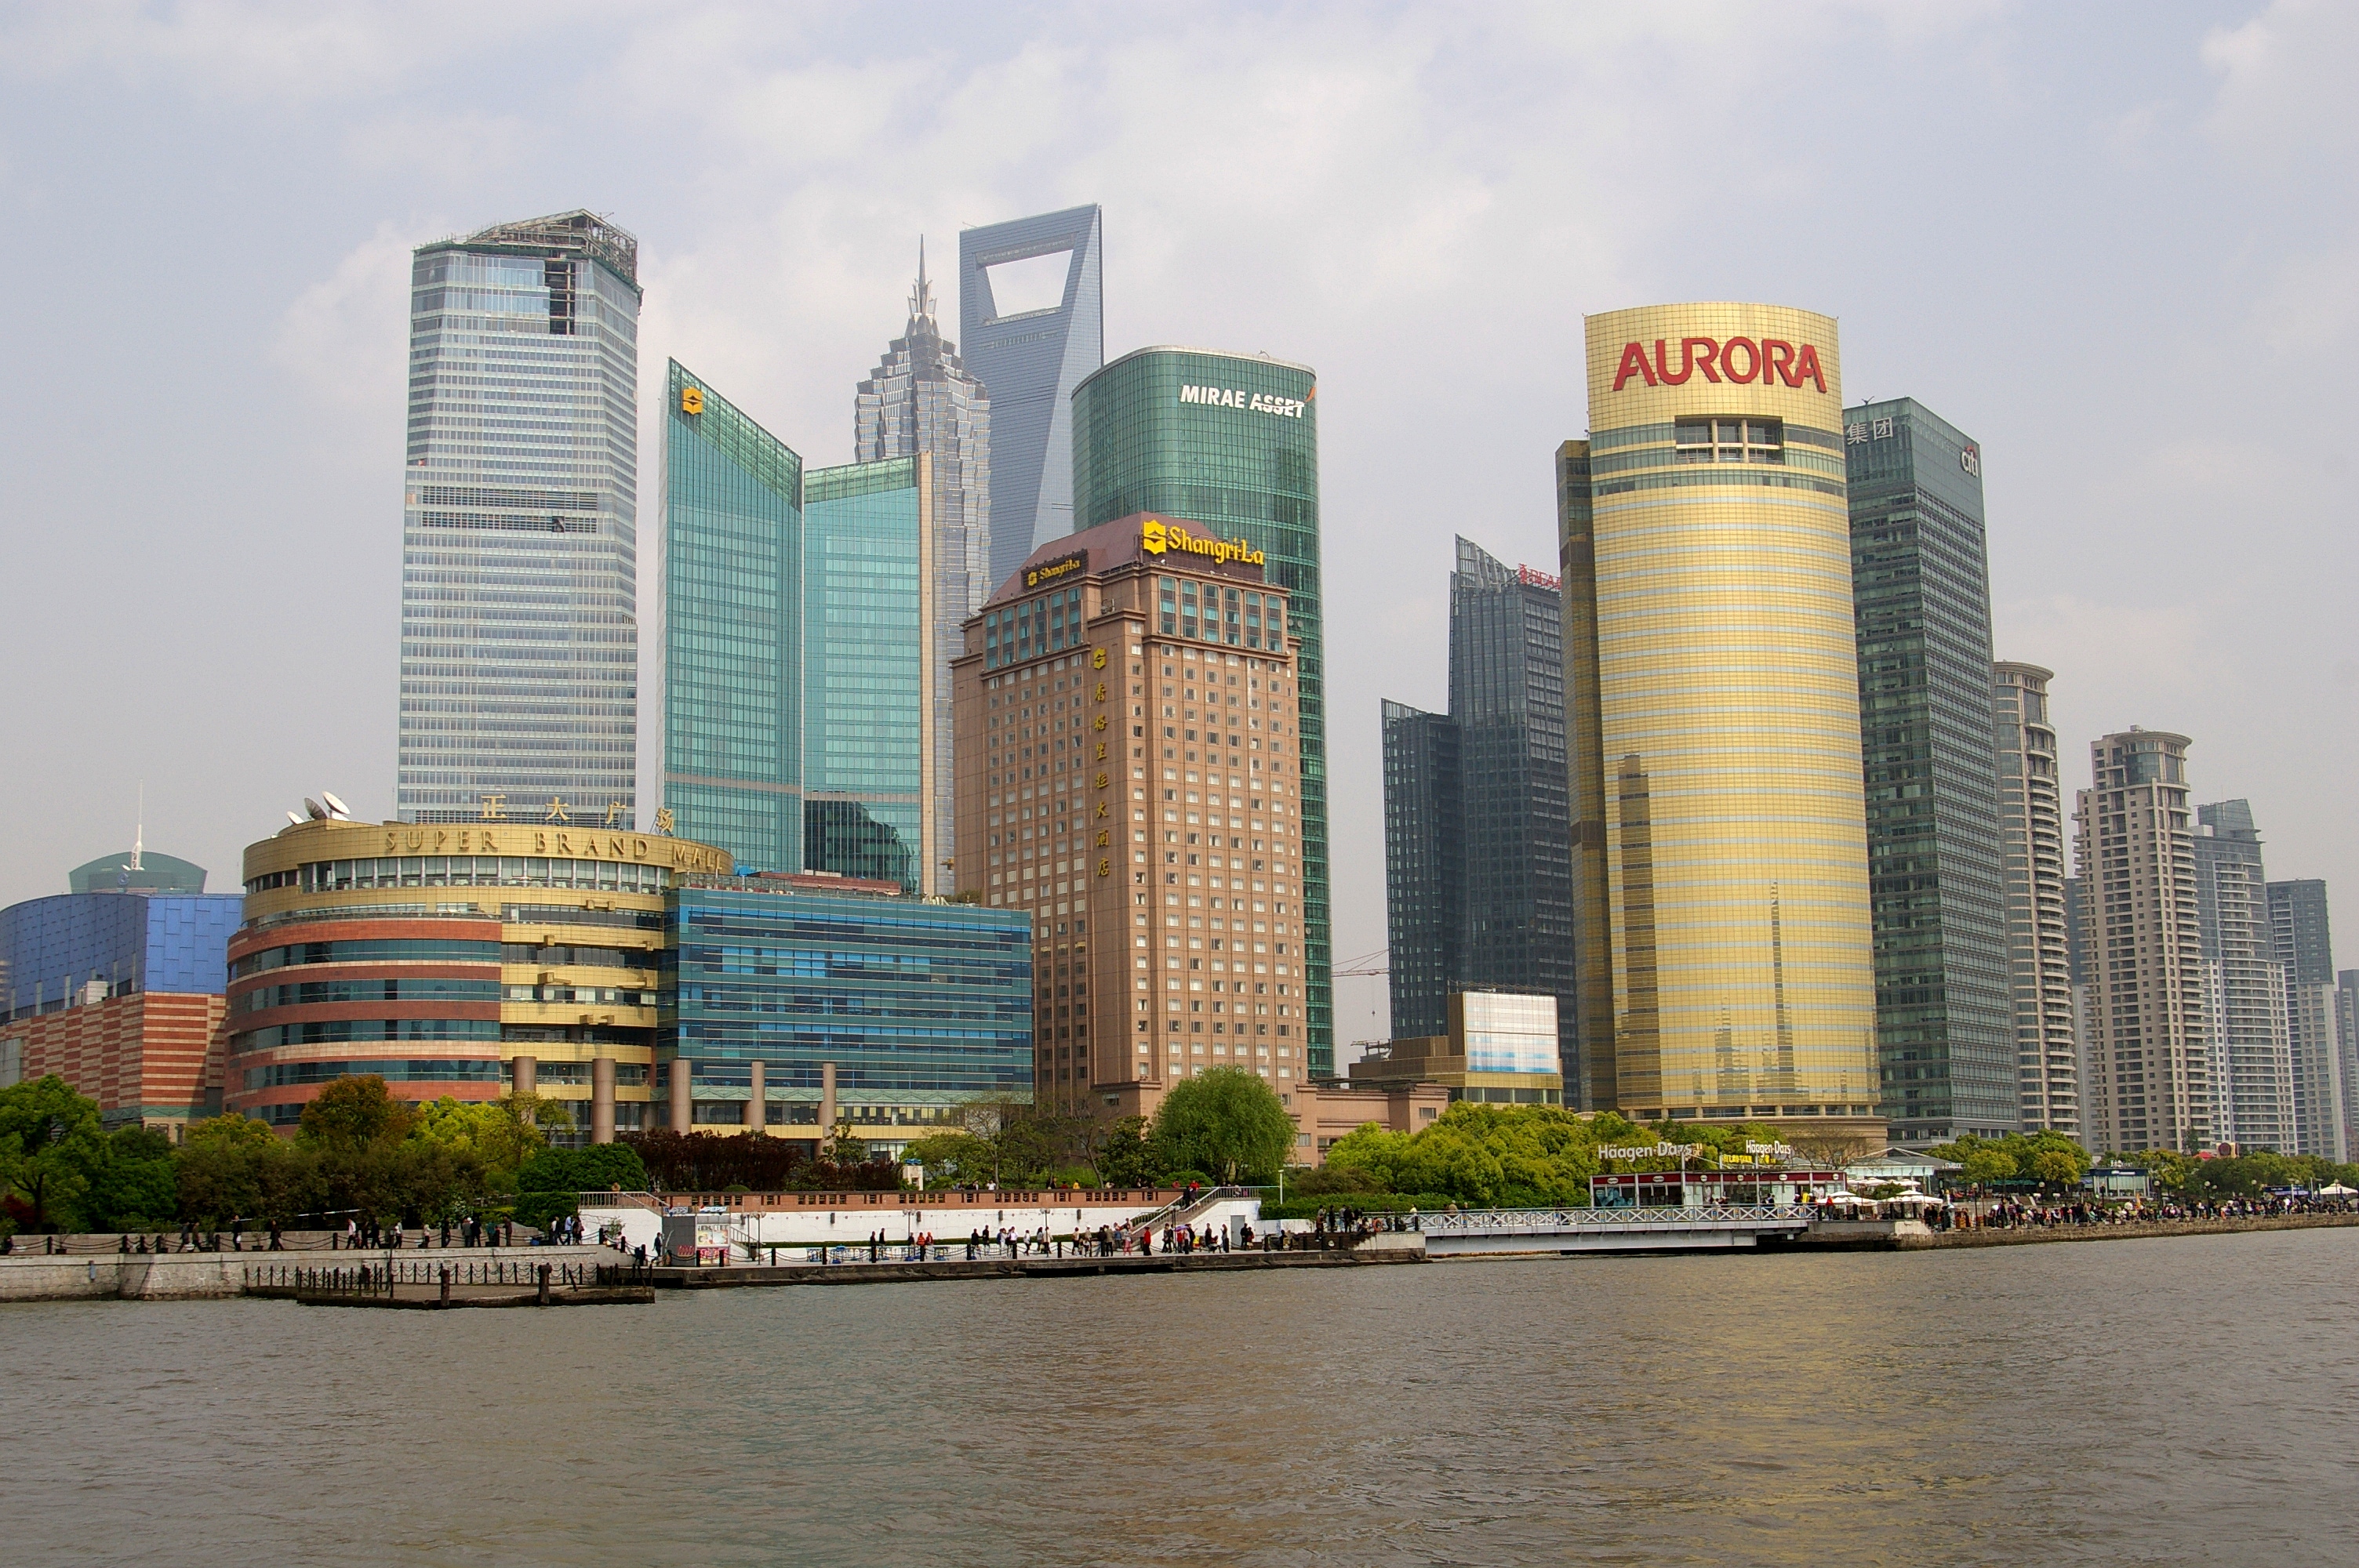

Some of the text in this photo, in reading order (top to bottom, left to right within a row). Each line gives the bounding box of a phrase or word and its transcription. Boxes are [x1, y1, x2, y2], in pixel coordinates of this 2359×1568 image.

[1612, 336, 1826, 393] AURORA
[1180, 385, 1305, 418] MIRAE ASSET
[1846, 416, 1893, 445] 集团
[1961, 451, 1979, 477] citi
[1168, 526, 1264, 565] Shangri-La
[480, 794, 674, 833] 正大广场
[385, 829, 723, 870] SUPER BRAND MALL
